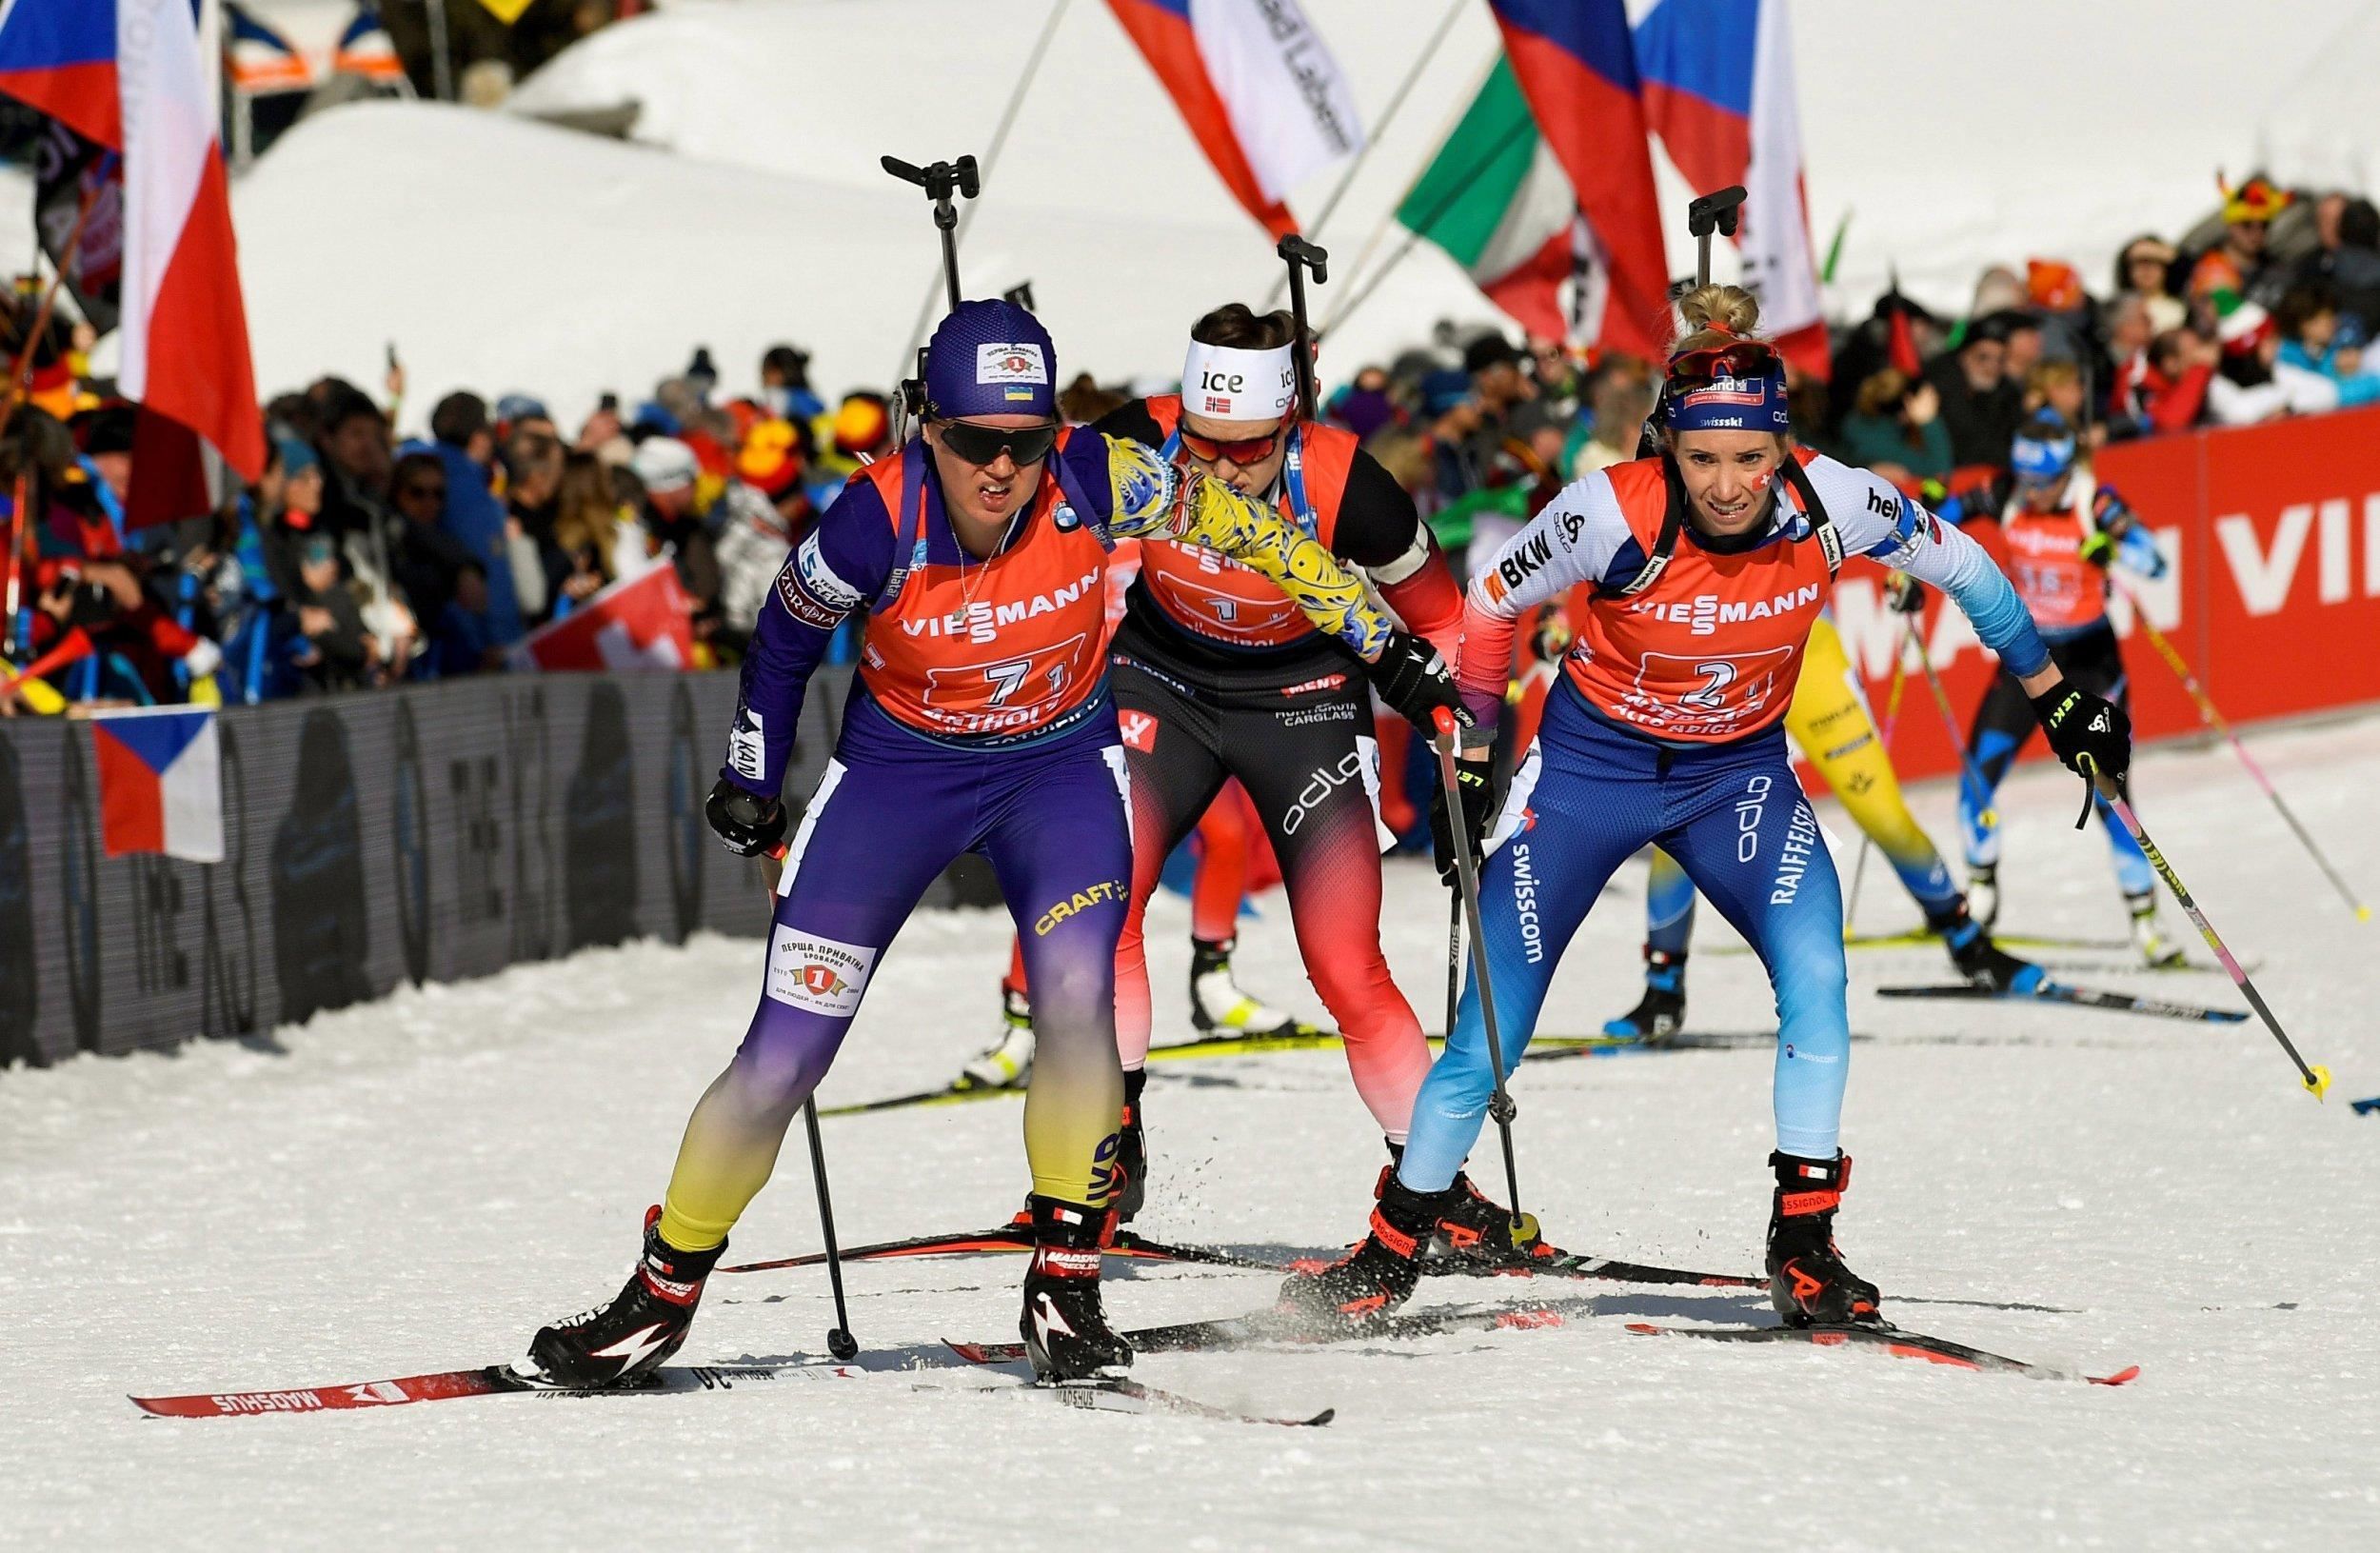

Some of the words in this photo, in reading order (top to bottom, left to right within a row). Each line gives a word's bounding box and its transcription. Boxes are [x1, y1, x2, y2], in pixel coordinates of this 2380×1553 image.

[1201, 369, 1243, 394] ice
[1499, 529, 1553, 589] BKW
[902, 566, 1100, 644] VIESSMANN
[1630, 582, 1819, 636] VIESSMANN
[982, 658, 1033, 707] 7
[1046, 662, 1067, 692] 1
[1679, 661, 1737, 707] 2
[1284, 710, 1355, 727] CARGLASS
[2049, 691, 2082, 729] LEKI
[1282, 751, 1362, 835] odlo
[1735, 776, 1773, 863] odlo
[1035, 882, 1113, 936] CRAFT
[1512, 844, 1543, 965] swisscom
[1450, 923, 1459, 968] SWIX
[808, 969, 825, 990] 1
[209, 1390, 323, 1413] MADSHUS
